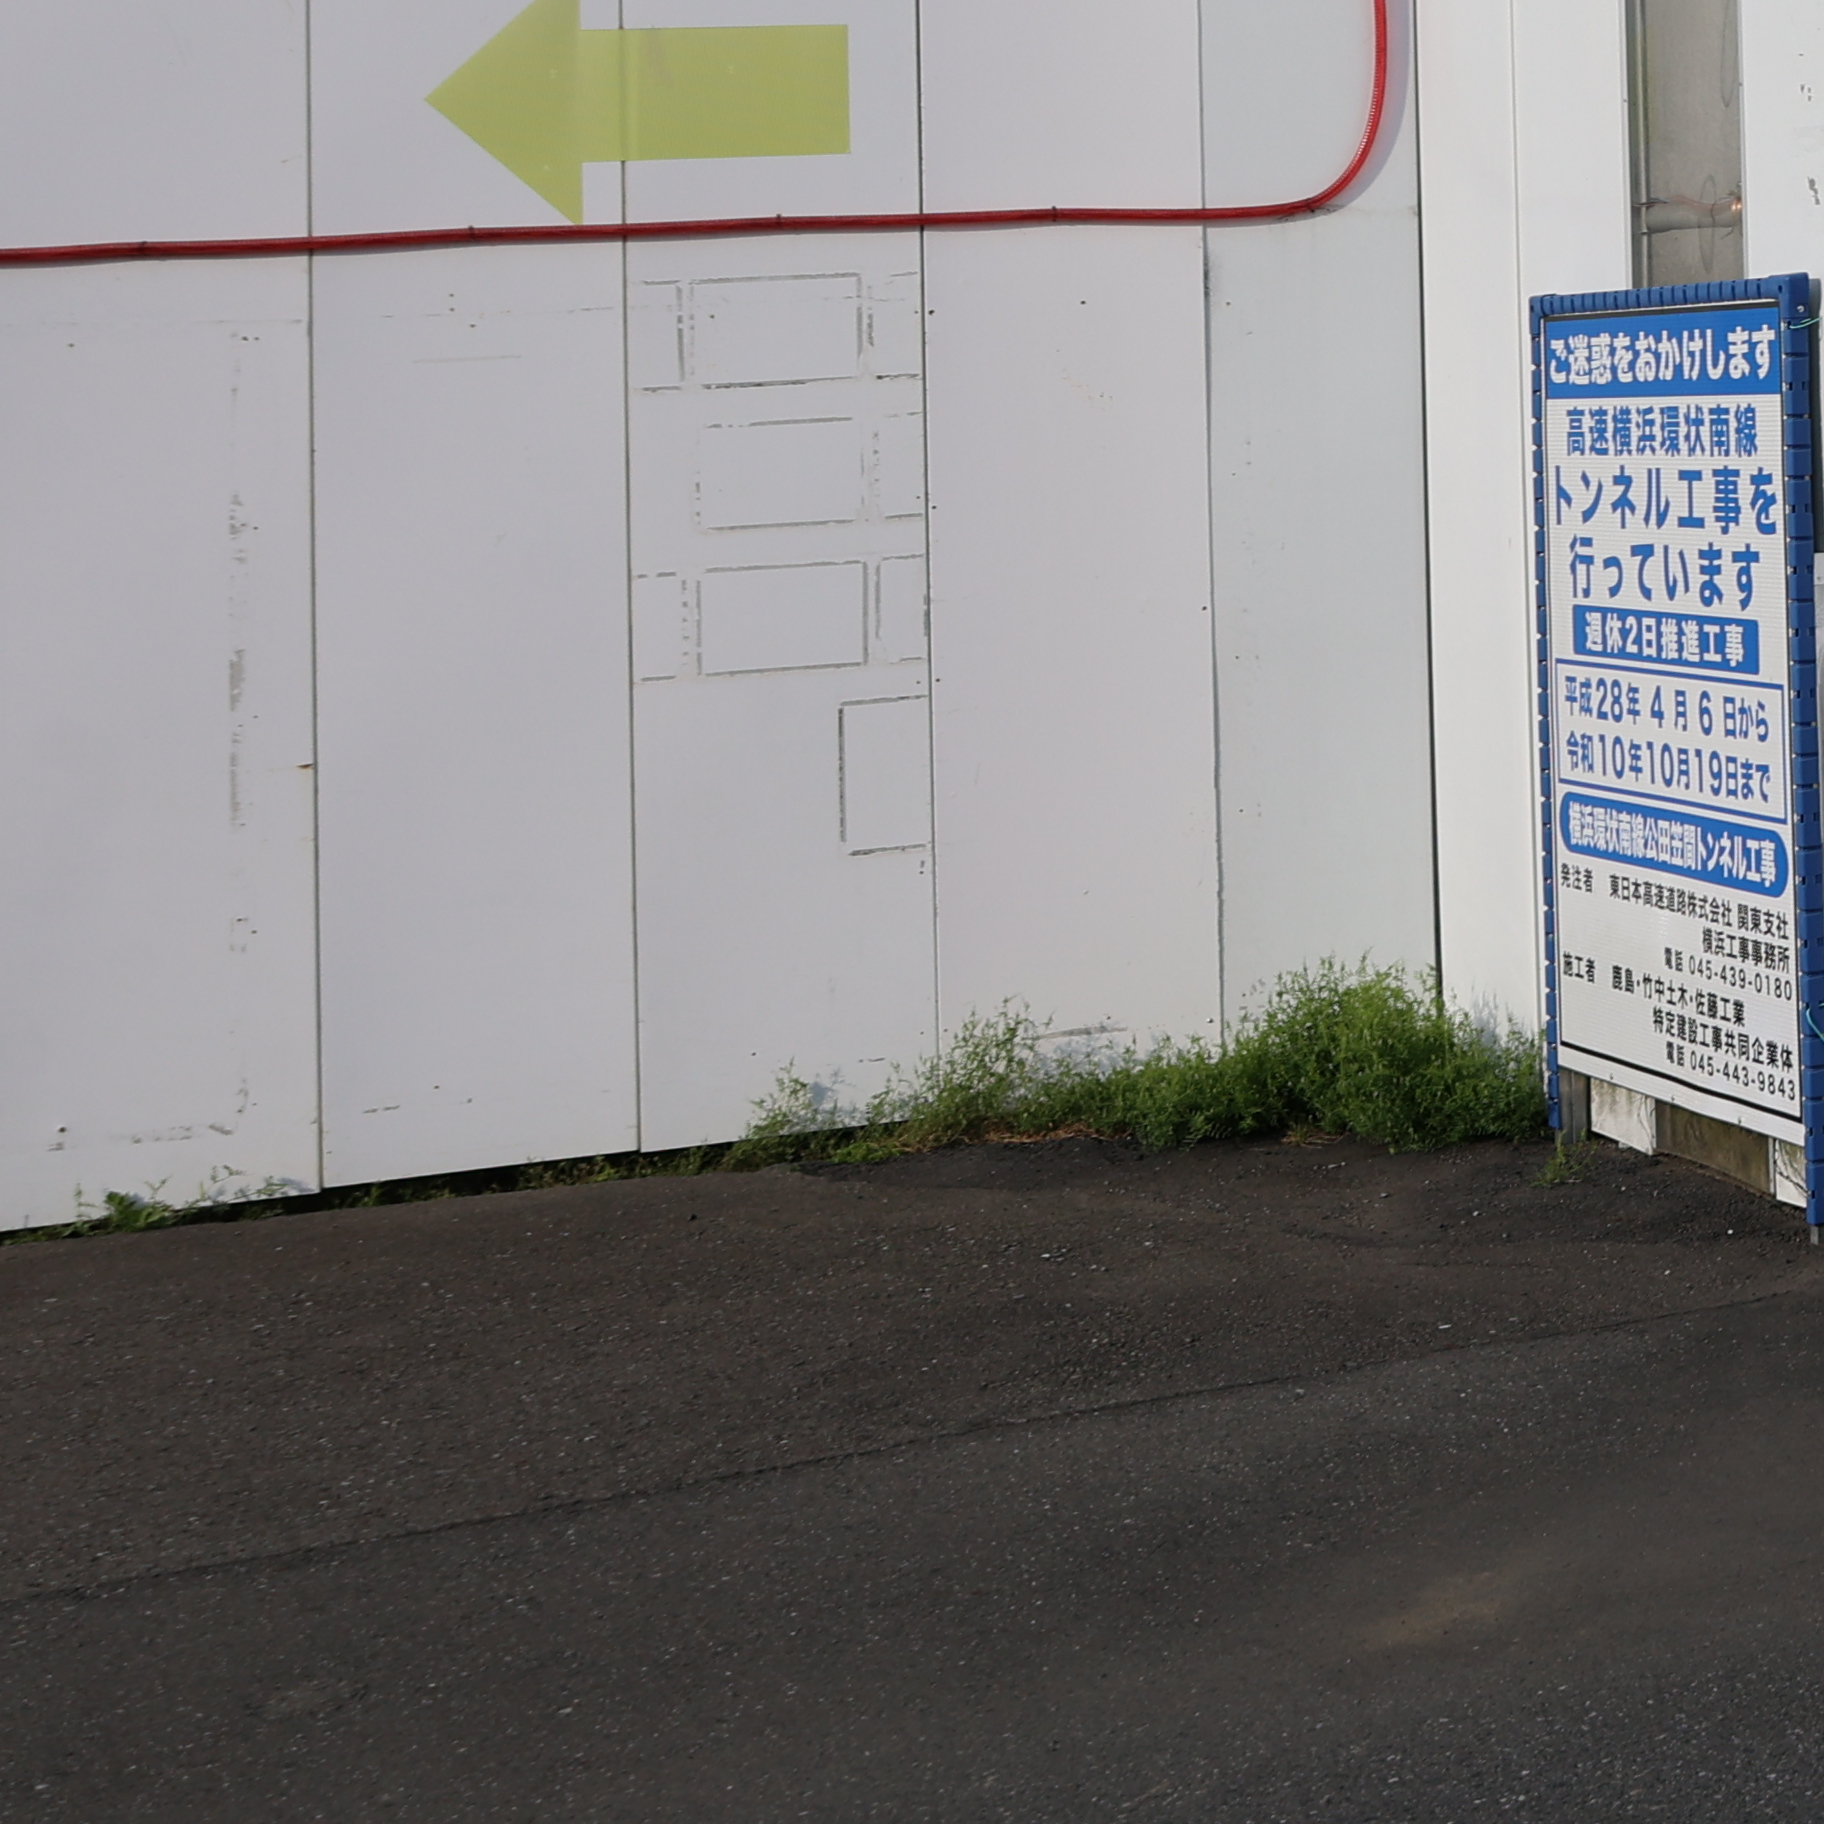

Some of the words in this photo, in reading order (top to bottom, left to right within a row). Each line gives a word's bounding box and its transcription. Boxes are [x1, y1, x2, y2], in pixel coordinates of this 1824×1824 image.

[1549, 324, 1776, 385] ご迷惑をおかけします
[1566, 404, 1759, 457] 高速横浜環状南線
[1554, 465, 1778, 536] トンネル工事を
[1569, 534, 1760, 611] 行っています
[1585, 611, 1745, 667] 週休2日推進工事
[1566, 730, 1771, 803] 令和10年10月19日まで
[1568, 800, 1777, 887] 横浜環状南線公田笠間トンネル工事
[1560, 862, 1594, 894] 発注者
[1608, 873, 1733, 928] 東日本高速道路株式会社
[1736, 903, 1790, 940] 関東支社
[1562, 951, 1596, 984] 施工者
[1663, 946, 1684, 972] 電話
[1688, 955, 1793, 1001] 045-439-0180
[1702, 927, 1790, 974] 横浜工事事務所
[1652, 1006, 1794, 1073] 特定建設工事共同企業体
[1665, 1041, 1685, 1068] 電話
[1690, 1050, 1796, 1101] 045-443-9843
